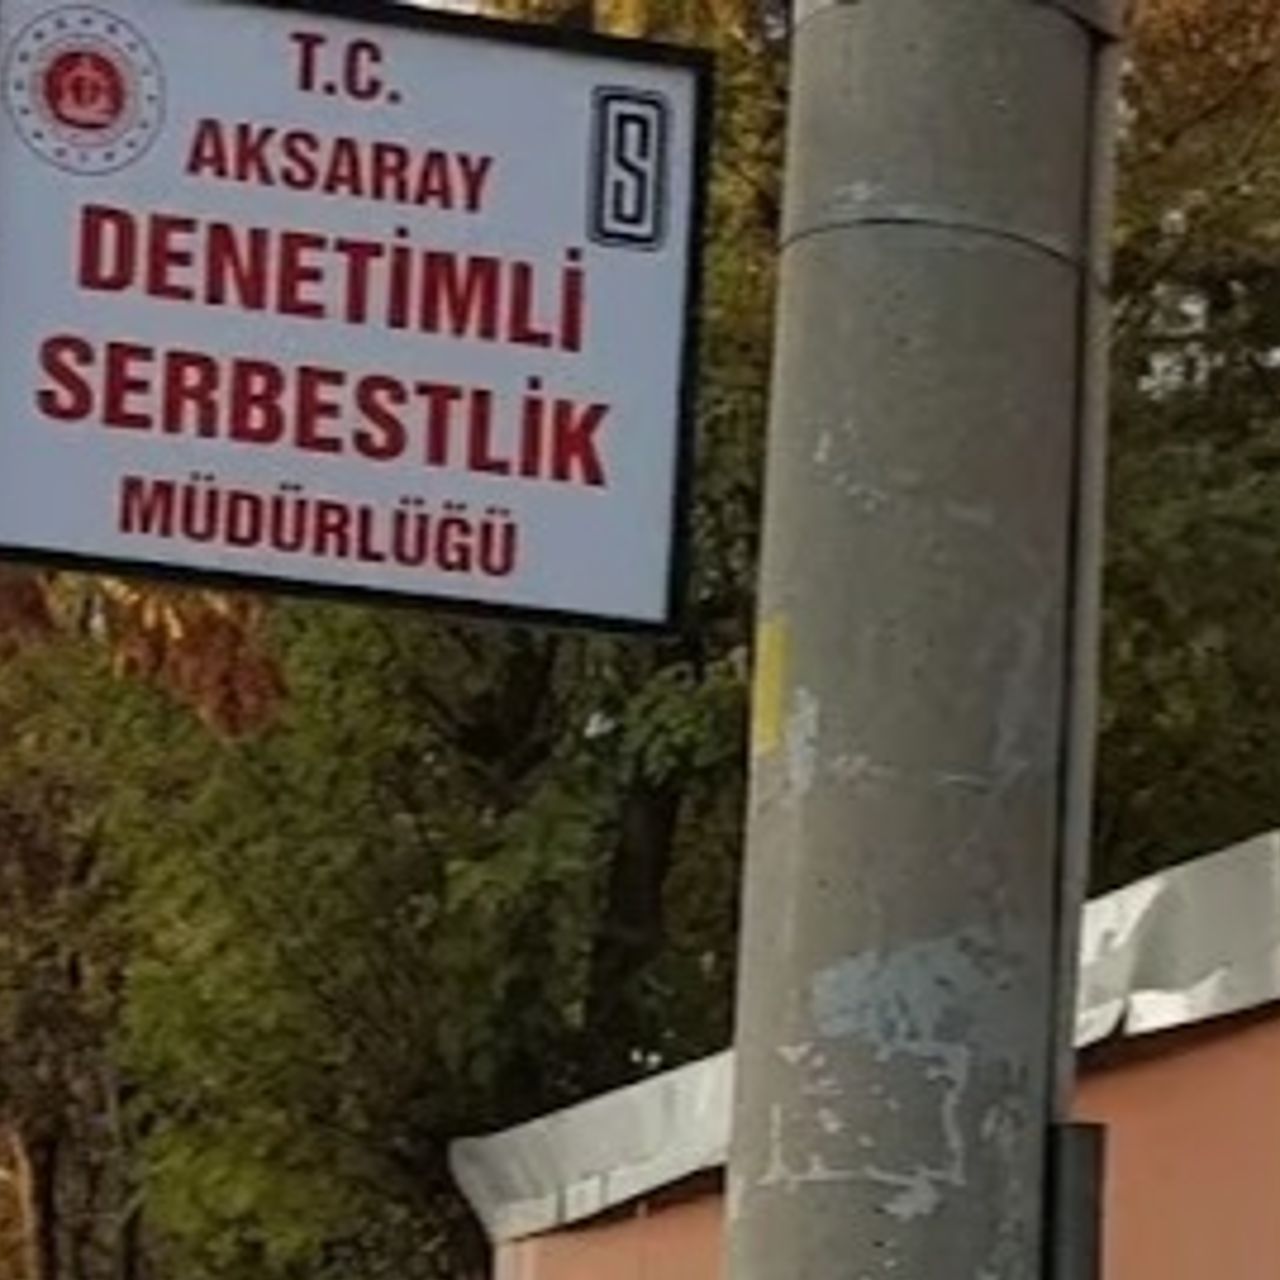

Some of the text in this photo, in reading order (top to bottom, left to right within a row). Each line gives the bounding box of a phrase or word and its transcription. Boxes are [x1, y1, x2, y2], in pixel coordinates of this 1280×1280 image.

[290, 32, 402, 104] T.C.
[186, 118, 493, 214] AKSARAY
[75, 204, 586, 353] DENETİMLİ
[36, 335, 610, 486] SERBESTLİK
